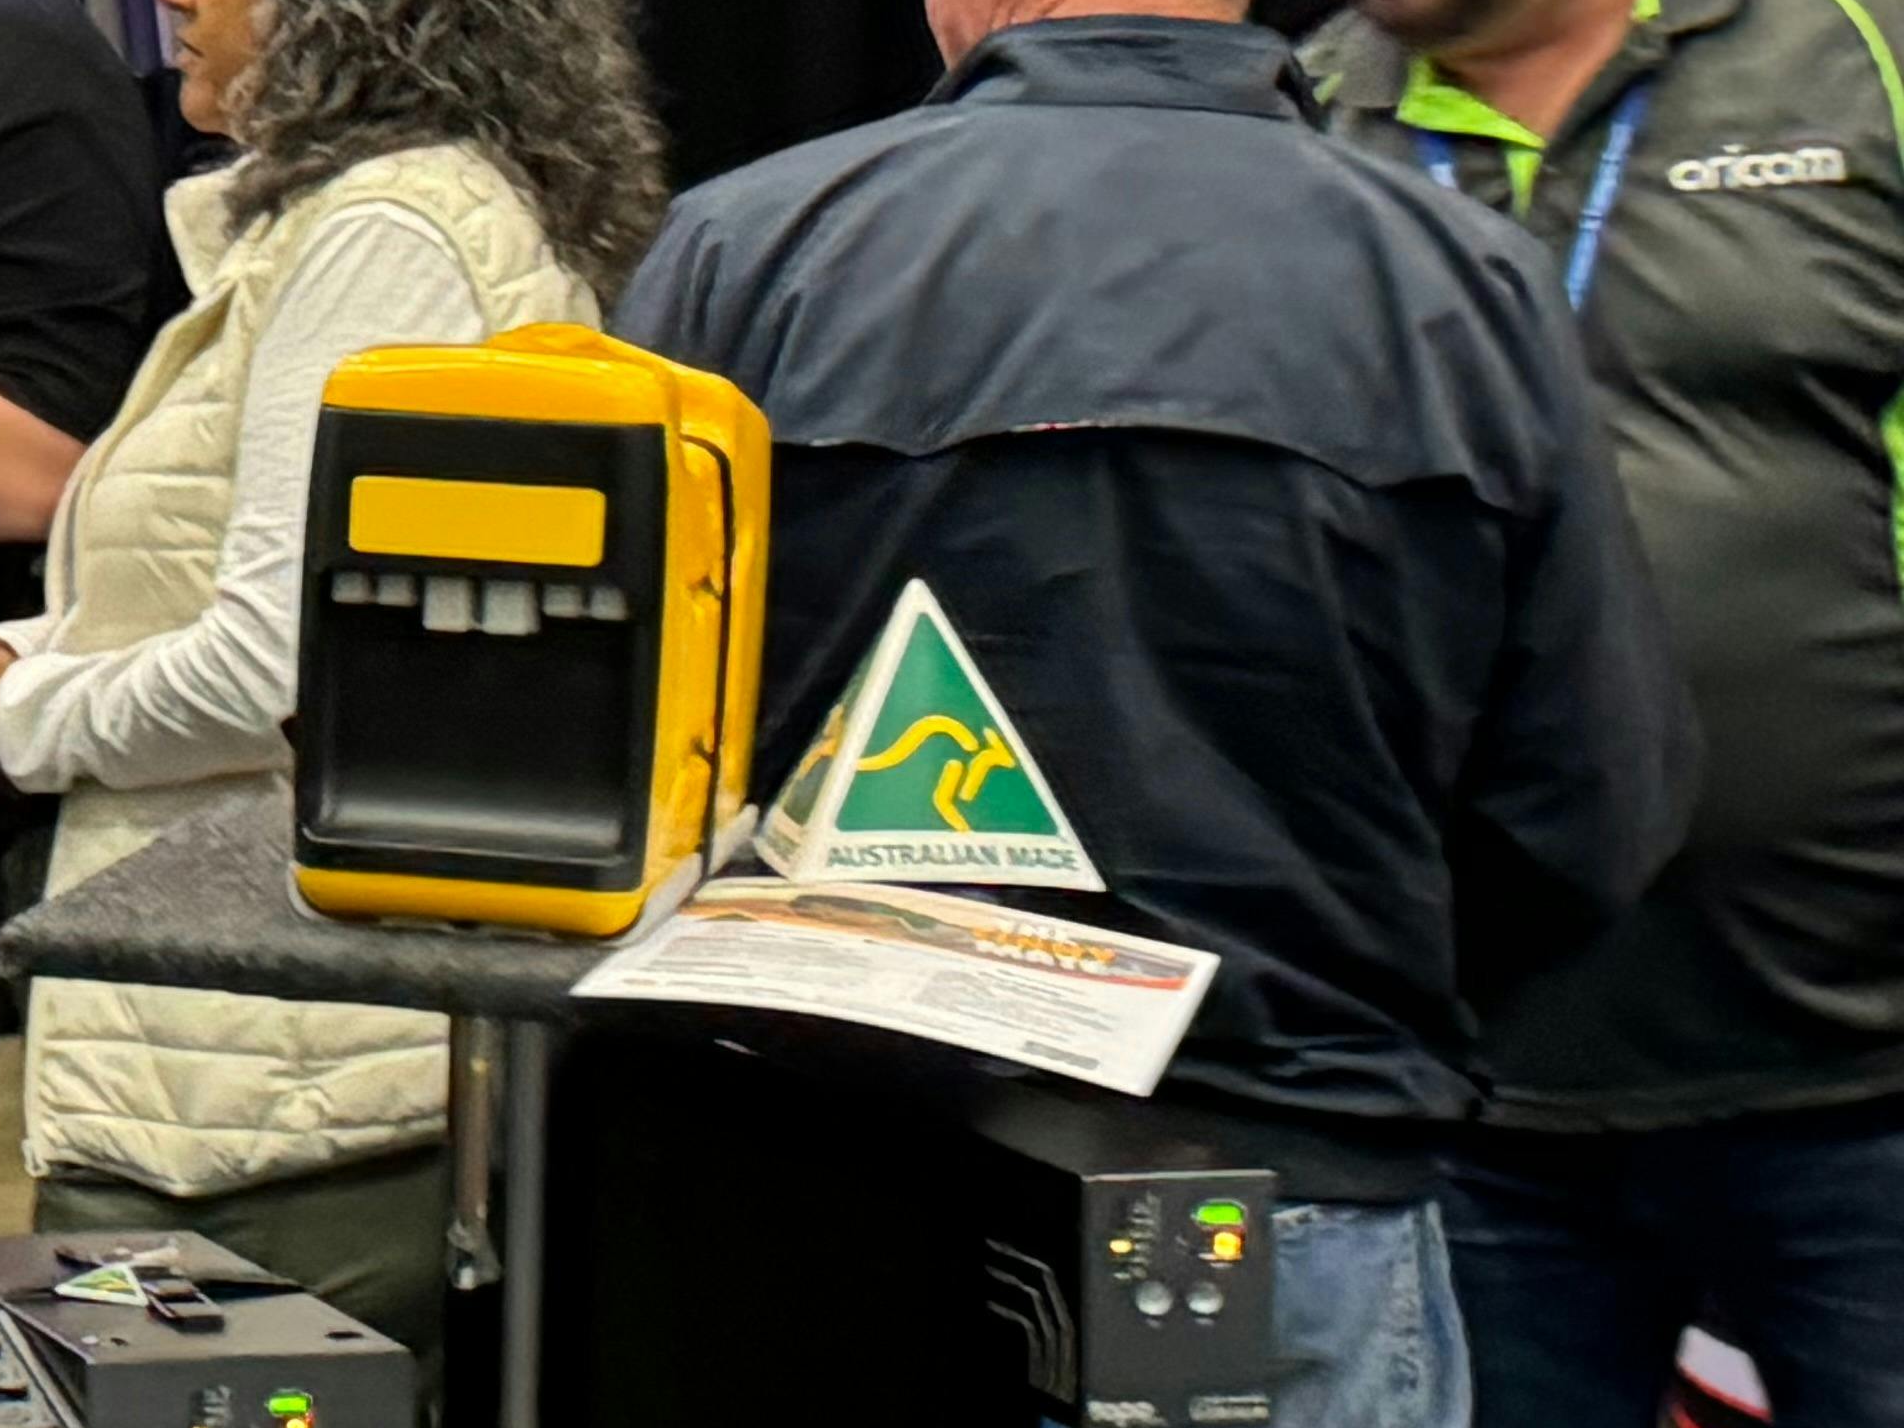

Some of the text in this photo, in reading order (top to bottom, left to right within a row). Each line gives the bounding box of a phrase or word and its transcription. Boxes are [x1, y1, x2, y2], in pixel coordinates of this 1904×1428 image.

[1667, 144, 1847, 191] oricom
[825, 843, 1081, 871] AUSTRALIAN MADE
